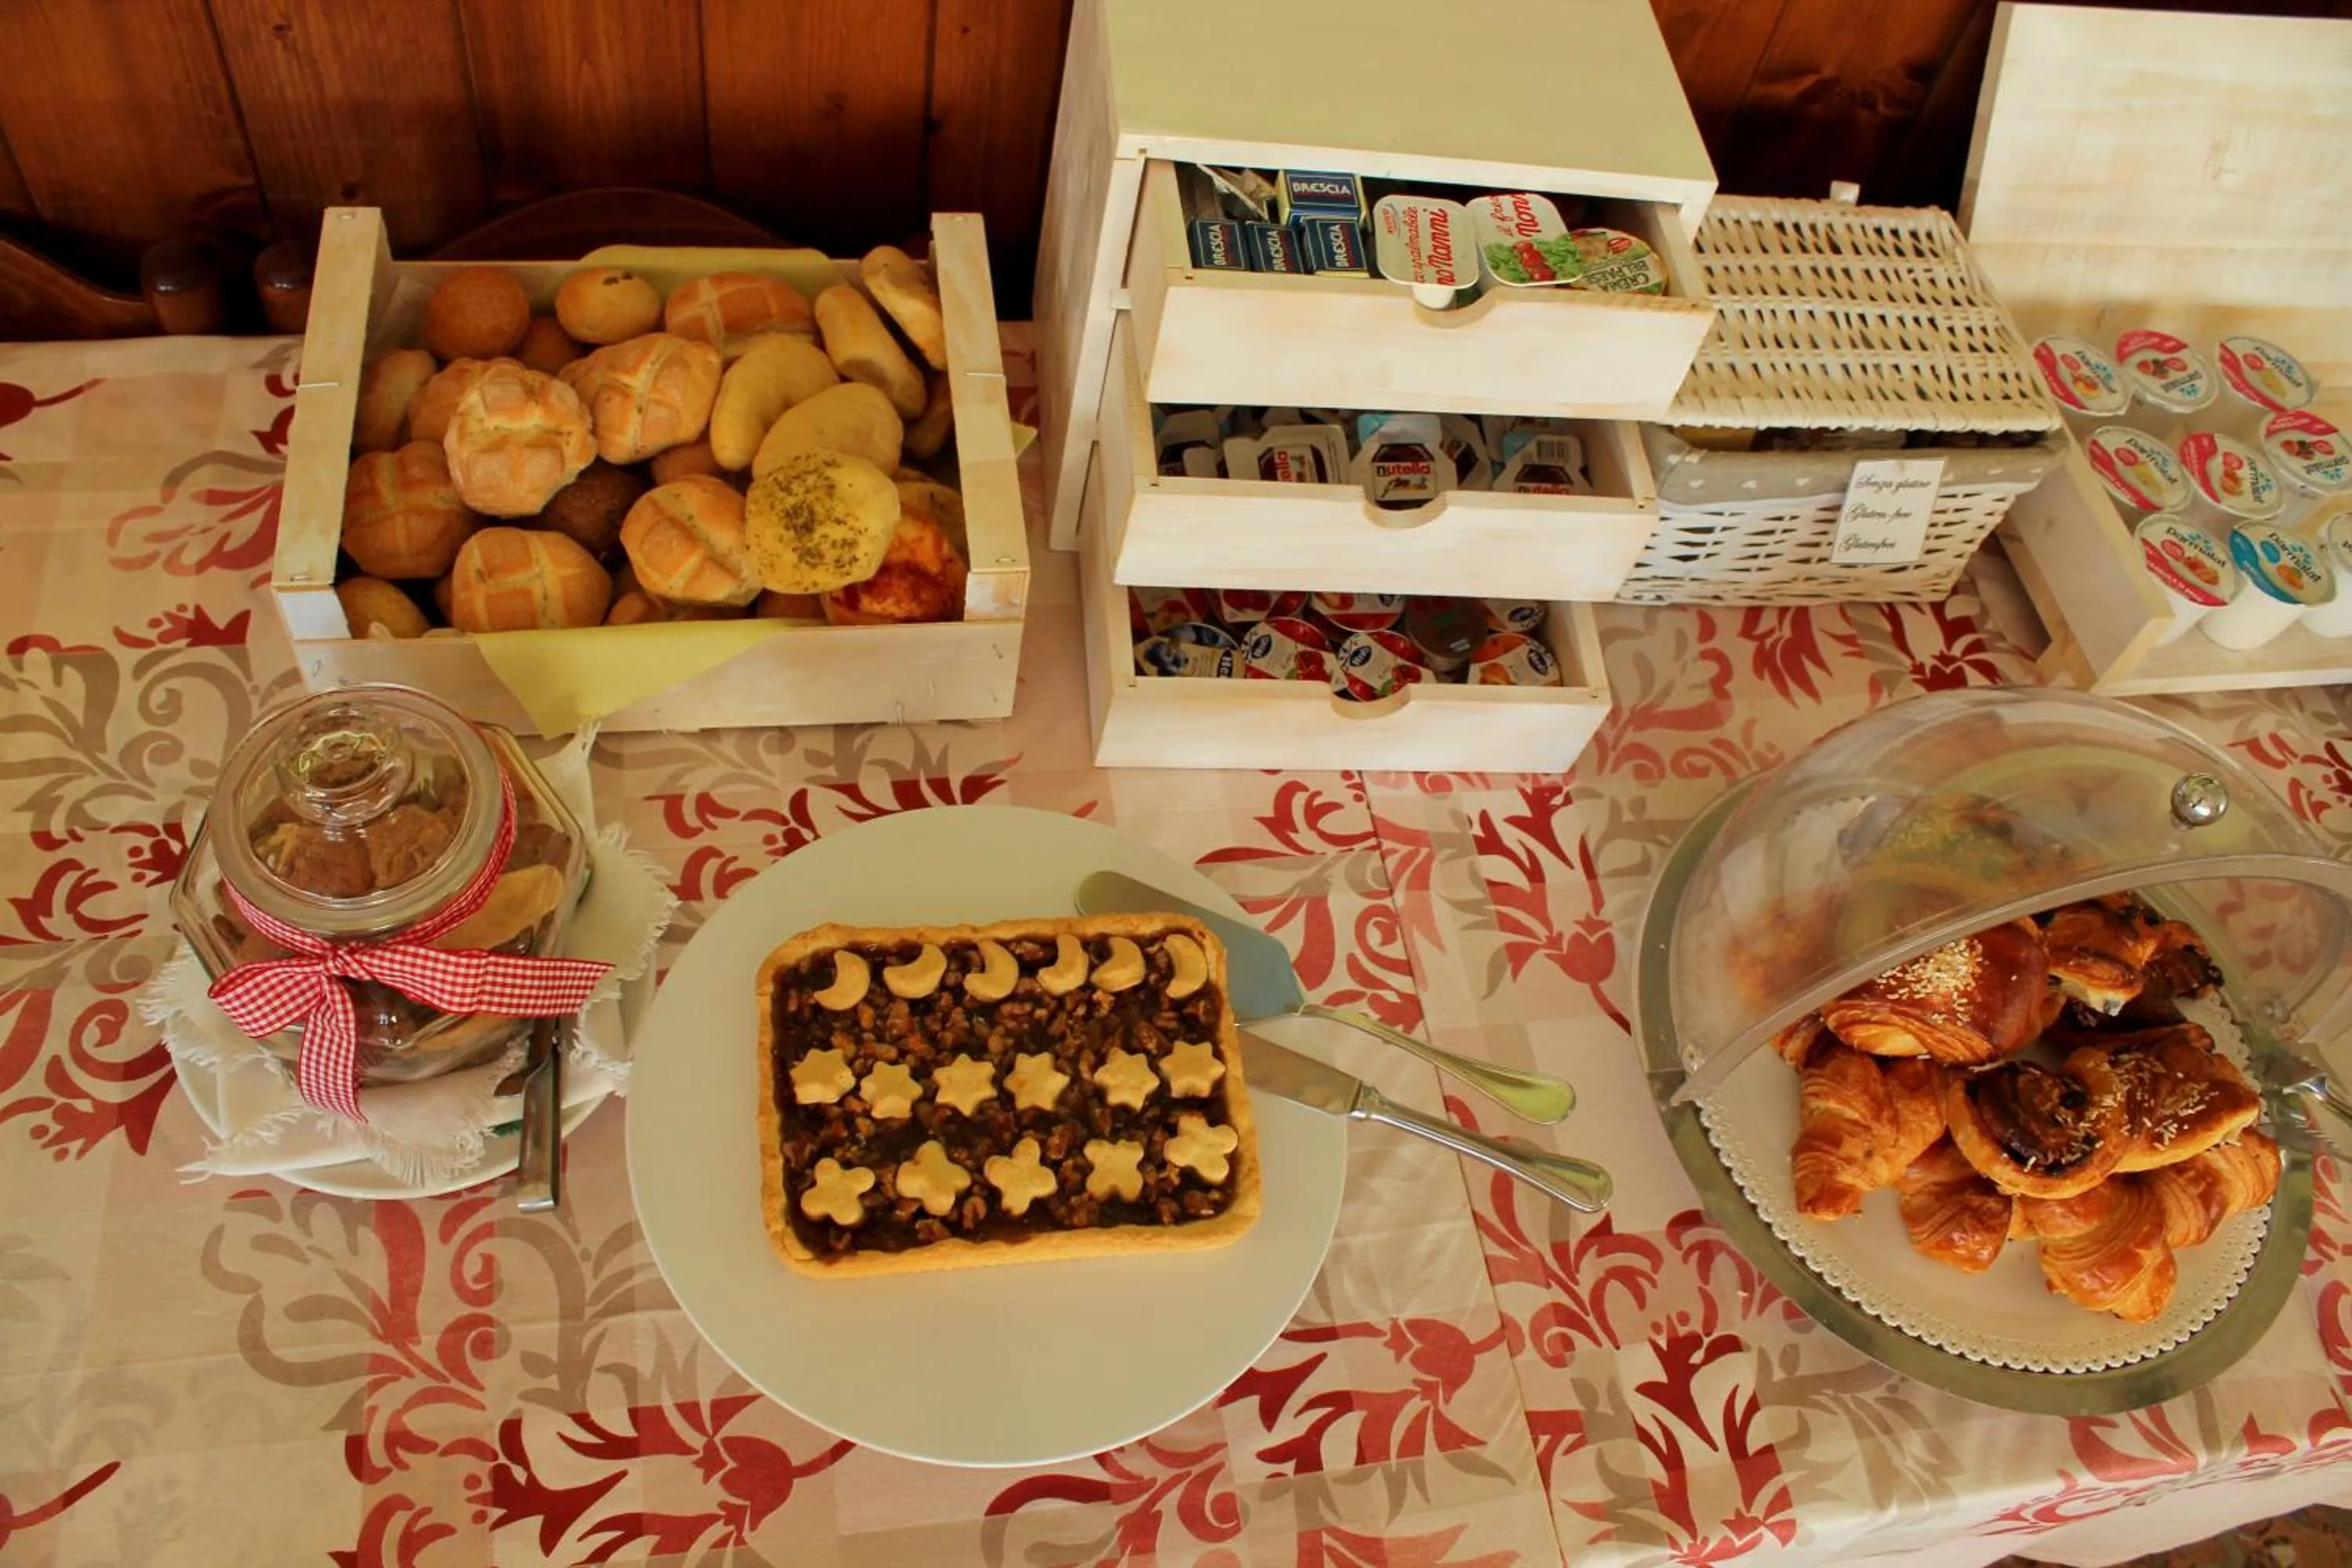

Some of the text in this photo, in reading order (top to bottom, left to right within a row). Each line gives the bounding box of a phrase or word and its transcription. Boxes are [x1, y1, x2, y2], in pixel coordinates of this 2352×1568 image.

[1292, 181, 1352, 195] BRESCIA
[1209, 224, 1227, 266] BRESCIA
[1267, 230, 1287, 271] BRESCIA
[1331, 224, 1350, 267] BRESCIA
[1376, 461, 1431, 477] nutella
